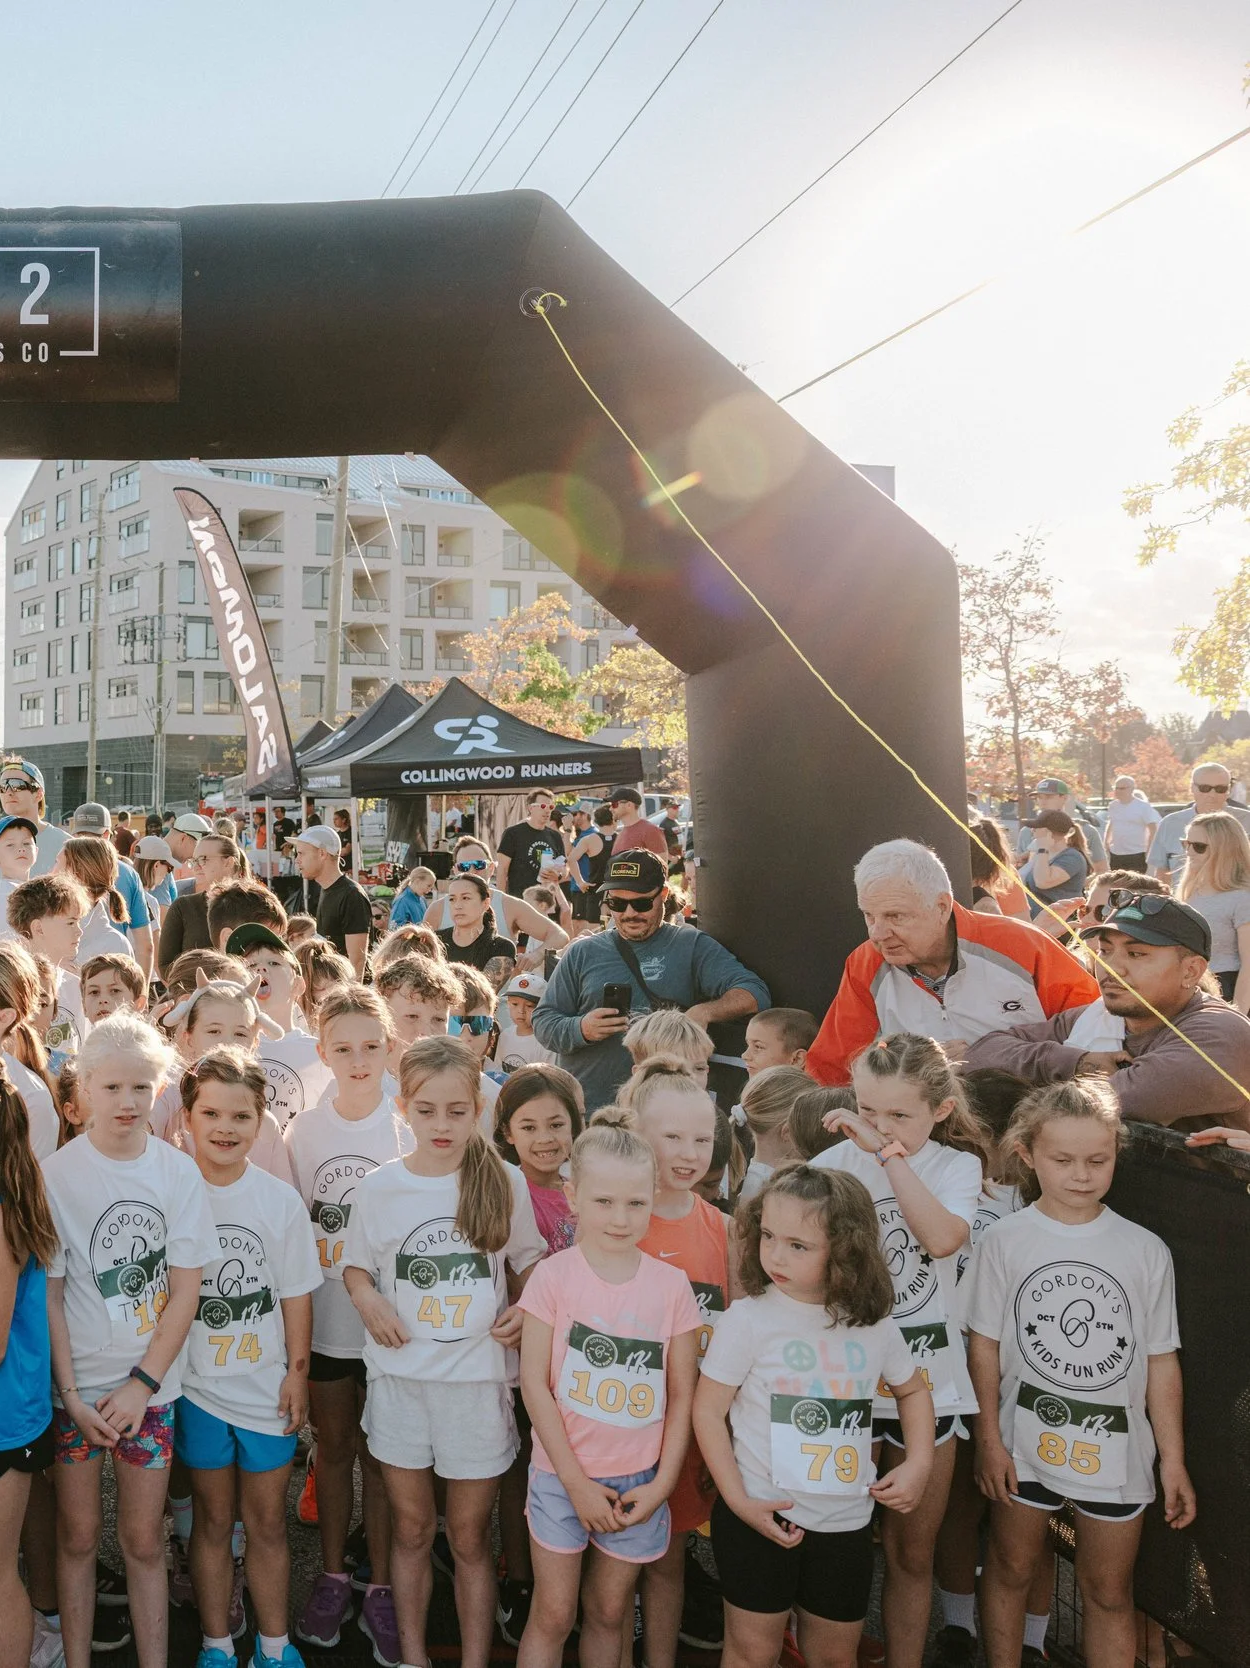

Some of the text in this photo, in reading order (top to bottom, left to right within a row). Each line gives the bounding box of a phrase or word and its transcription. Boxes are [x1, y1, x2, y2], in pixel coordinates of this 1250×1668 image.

[21, 342, 49, 363] CO
[401, 761, 592, 785] COLLINGWOOD RUNNERS
[275, 1100, 288, 1108] 5TH
[112, 1256, 128, 1267] OCT
[448, 1262, 478, 1287] 1K
[245, 1276, 259, 1284] 5TH
[908, 1268, 930, 1296] RUN
[1031, 1273, 1123, 1314] GORDON'S
[241, 1299, 263, 1326] 1K
[417, 1294, 473, 1329] 47
[1036, 1313, 1115, 1331] OCT 5TH
[208, 1332, 263, 1367] 74
[625, 1349, 653, 1376] 1K
[1030, 1340, 1123, 1378] KIDS FUN RUN
[568, 1370, 656, 1419] 109
[839, 1410, 864, 1437] 1K
[1080, 1413, 1115, 1439] 1K
[800, 1442, 860, 1484] 79
[1036, 1431, 1102, 1476] 85
